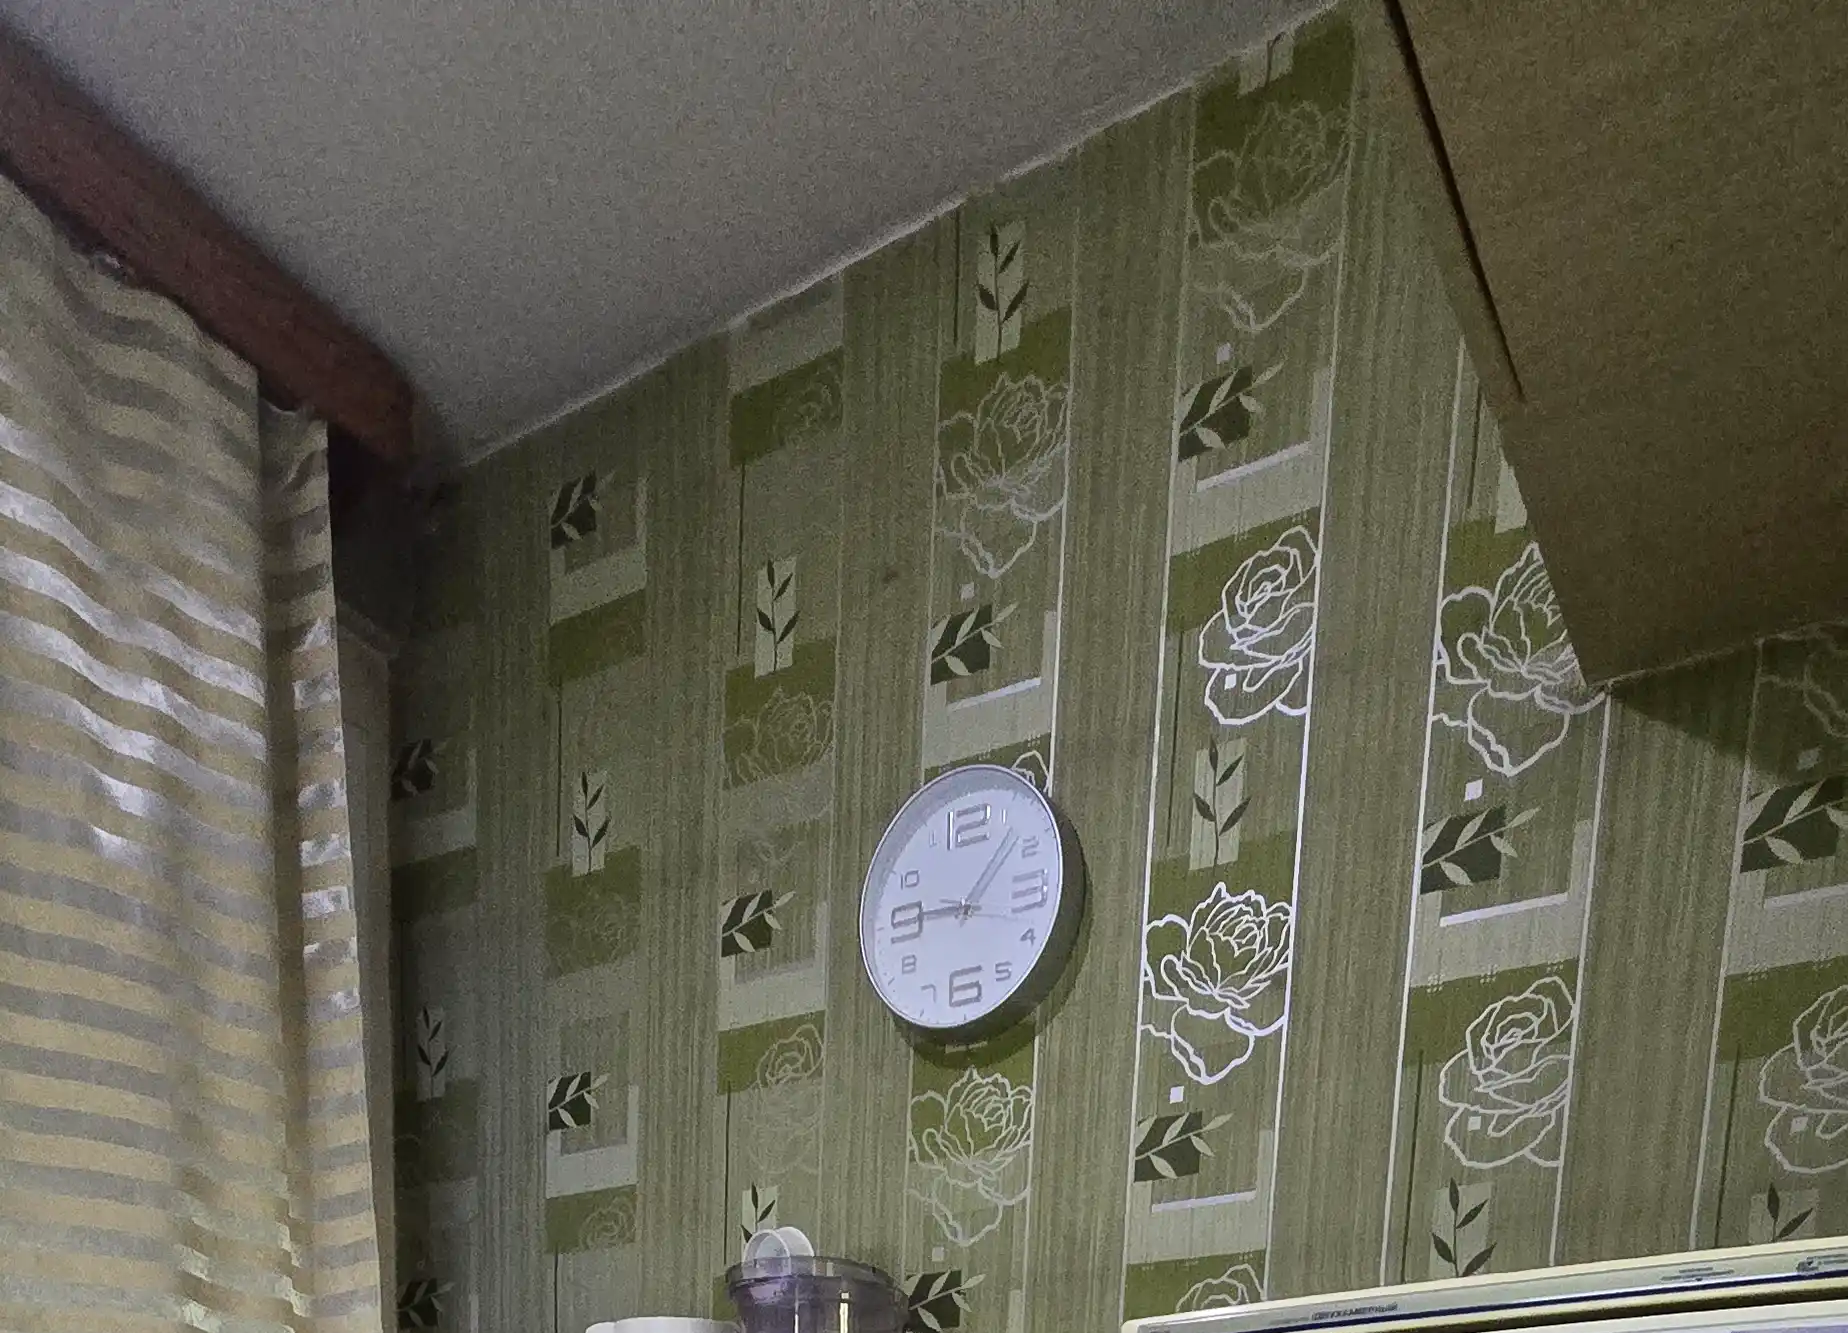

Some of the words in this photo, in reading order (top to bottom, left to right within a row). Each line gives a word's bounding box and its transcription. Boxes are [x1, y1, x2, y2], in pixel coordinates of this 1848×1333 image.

[947, 804, 991, 850] 12
[1021, 836, 1040, 858] 2
[900, 870, 920, 890] 10
[1011, 868, 1048, 914] 3
[891, 900, 924, 944] 9
[1020, 928, 1037, 946] 4
[901, 954, 918, 974] 8
[995, 961, 1012, 982] 5
[921, 984, 937, 1002] 7
[950, 965, 983, 1008] 6
